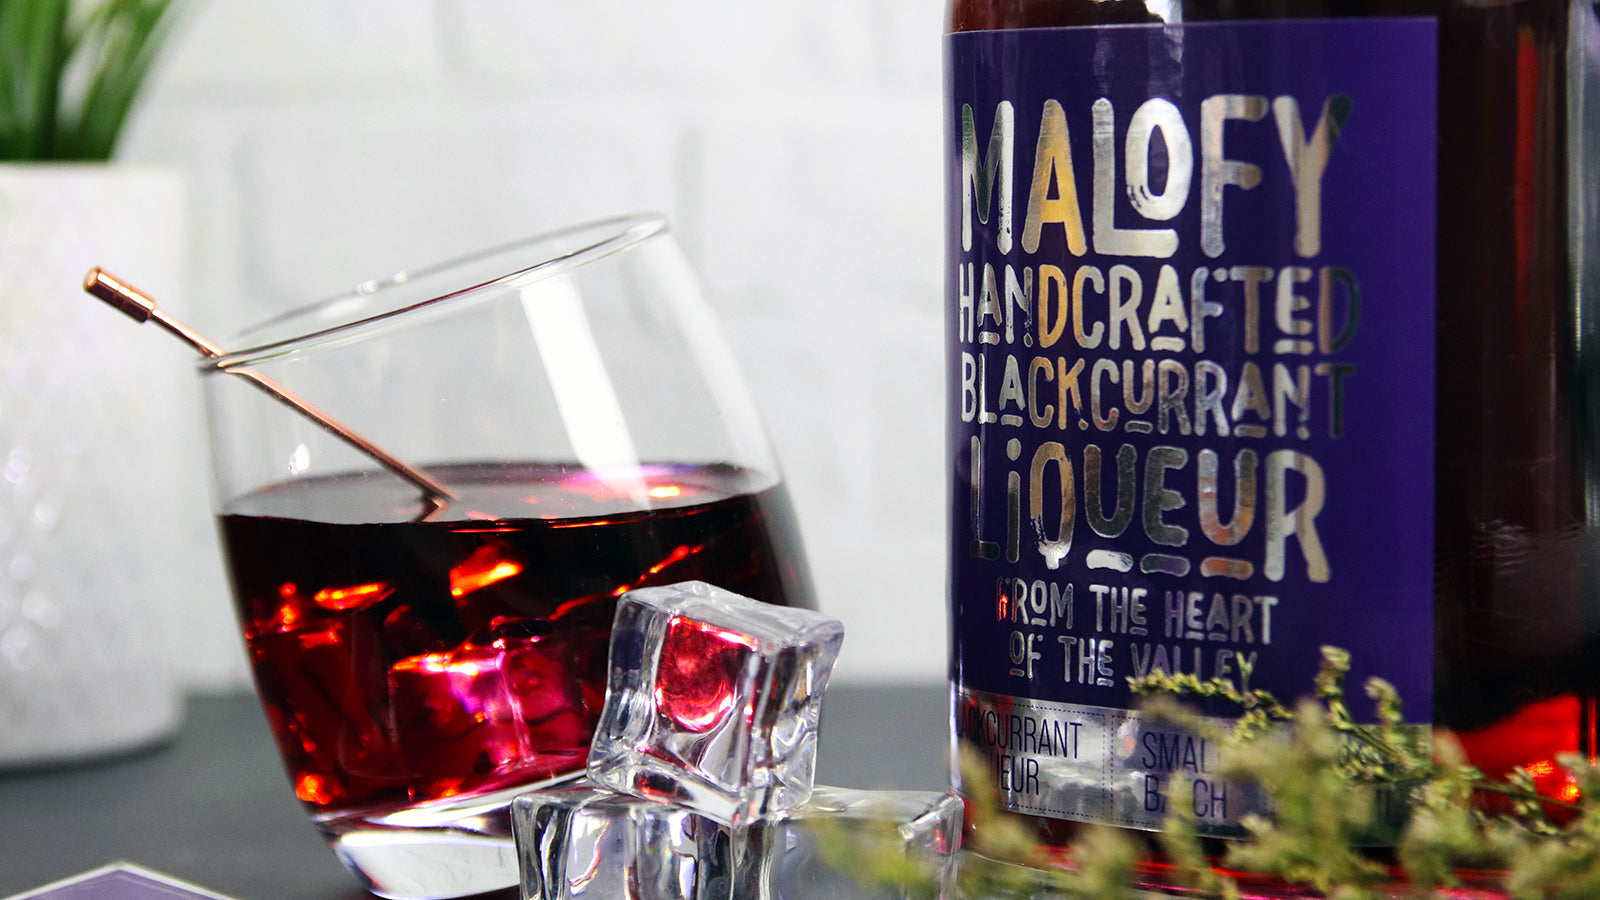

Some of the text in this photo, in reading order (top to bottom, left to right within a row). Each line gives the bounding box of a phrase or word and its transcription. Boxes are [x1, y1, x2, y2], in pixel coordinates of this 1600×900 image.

[961, 94, 1353, 258] MALOFY
[959, 262, 1361, 354] HANDCRAFTED
[961, 351, 1356, 440] BLACKCURRANT
[997, 577, 1278, 645] FROM THE HEART
[1009, 631, 1043, 679] OF
[1058, 636, 1114, 687] THE
[1142, 731, 1215, 774] SMAL
[1144, 774, 1227, 819] BCH
